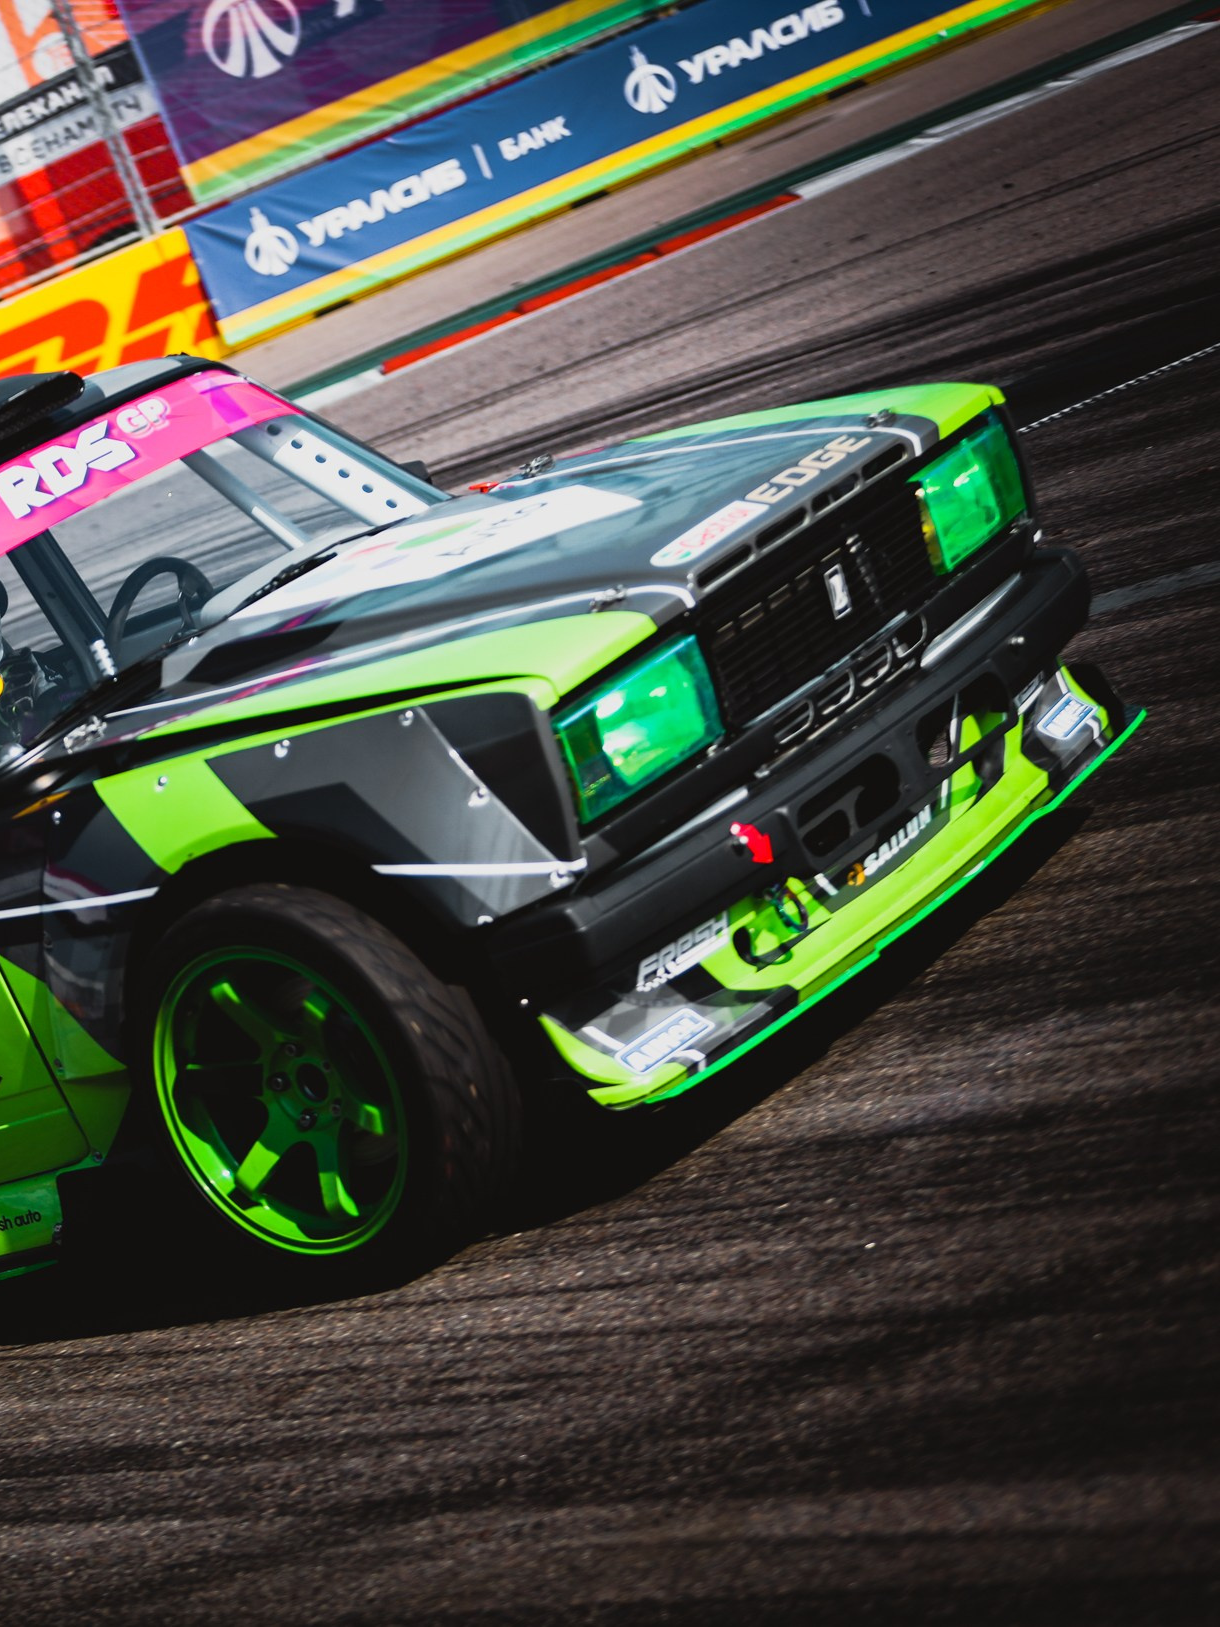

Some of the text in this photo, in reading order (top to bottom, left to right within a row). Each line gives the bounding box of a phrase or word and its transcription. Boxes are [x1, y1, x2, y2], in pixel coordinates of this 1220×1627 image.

[676, 0, 845, 84] УРАЛСИБ
[296, 115, 573, 247] УРАЛСИБ БАНК
[116, 398, 169, 435] GP
[745, 434, 873, 504] EDGE
[863, 804, 932, 876] SAILUN
[14, 1209, 42, 1226] auto
